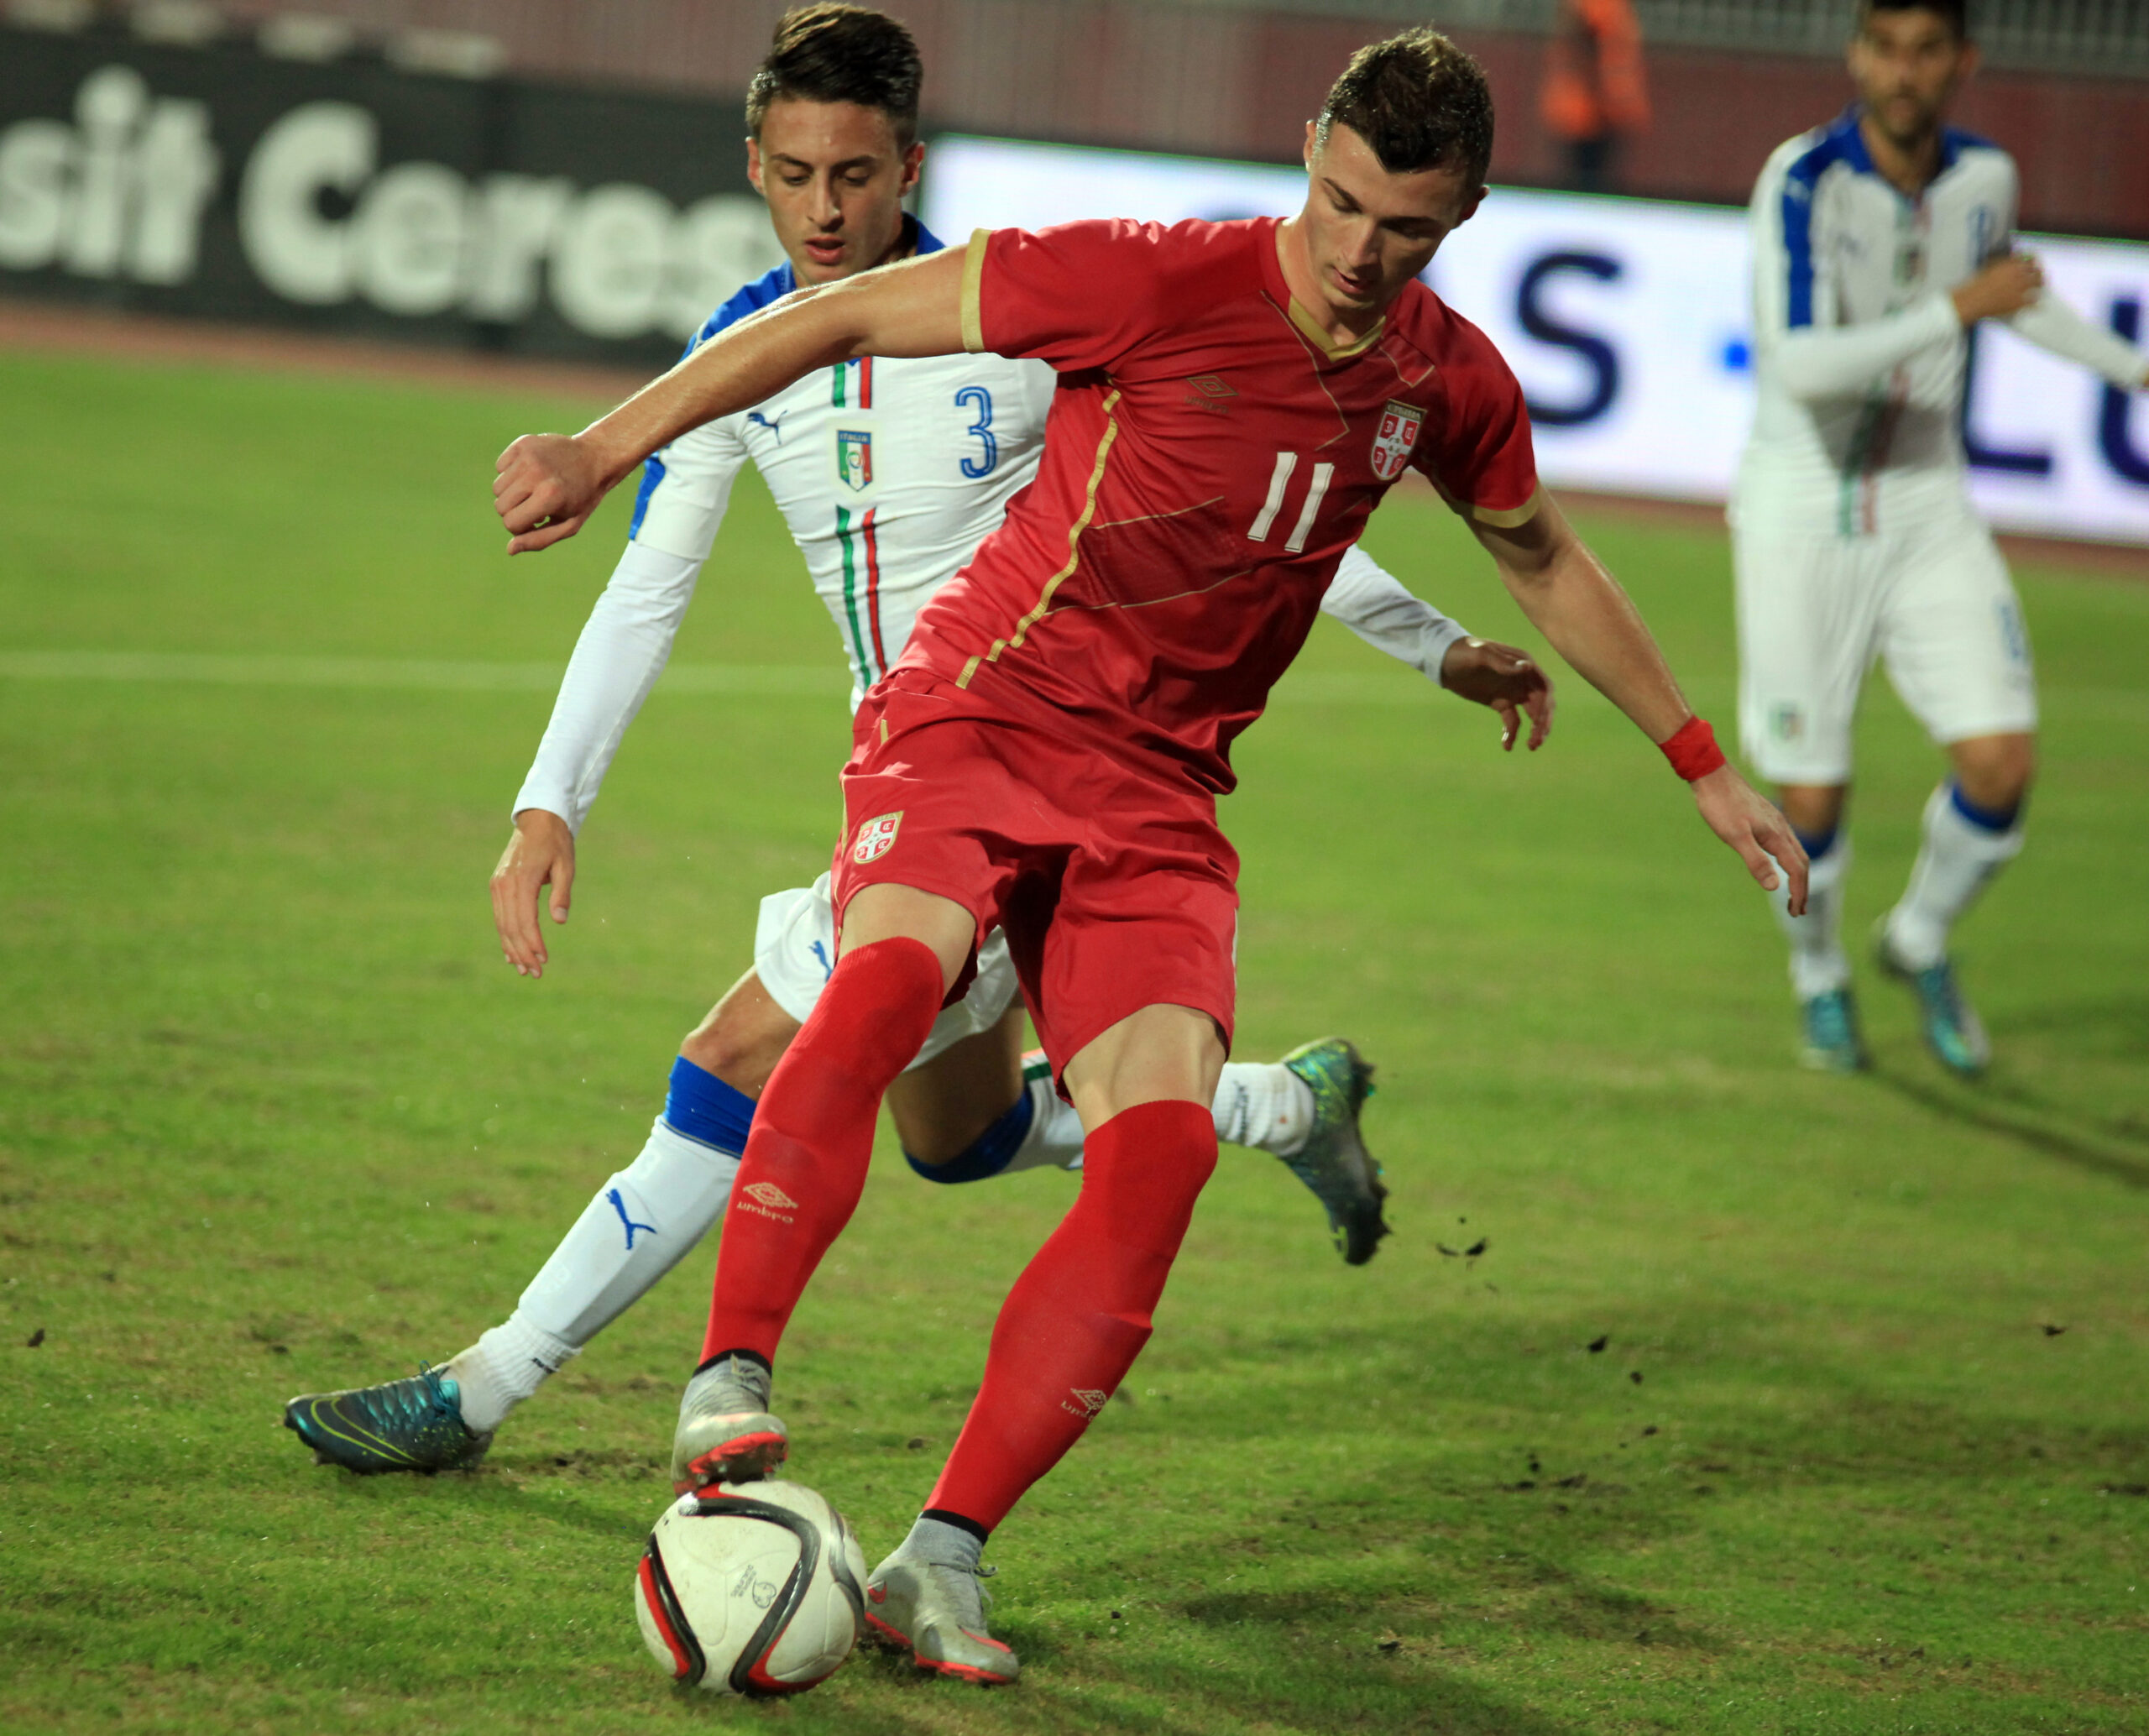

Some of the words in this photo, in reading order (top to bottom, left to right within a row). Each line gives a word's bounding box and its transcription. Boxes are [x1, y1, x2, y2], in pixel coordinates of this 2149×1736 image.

[839, 433, 870, 443] ITALIA
[954, 385, 997, 478] 3
[1247, 451, 1335, 553] 11
